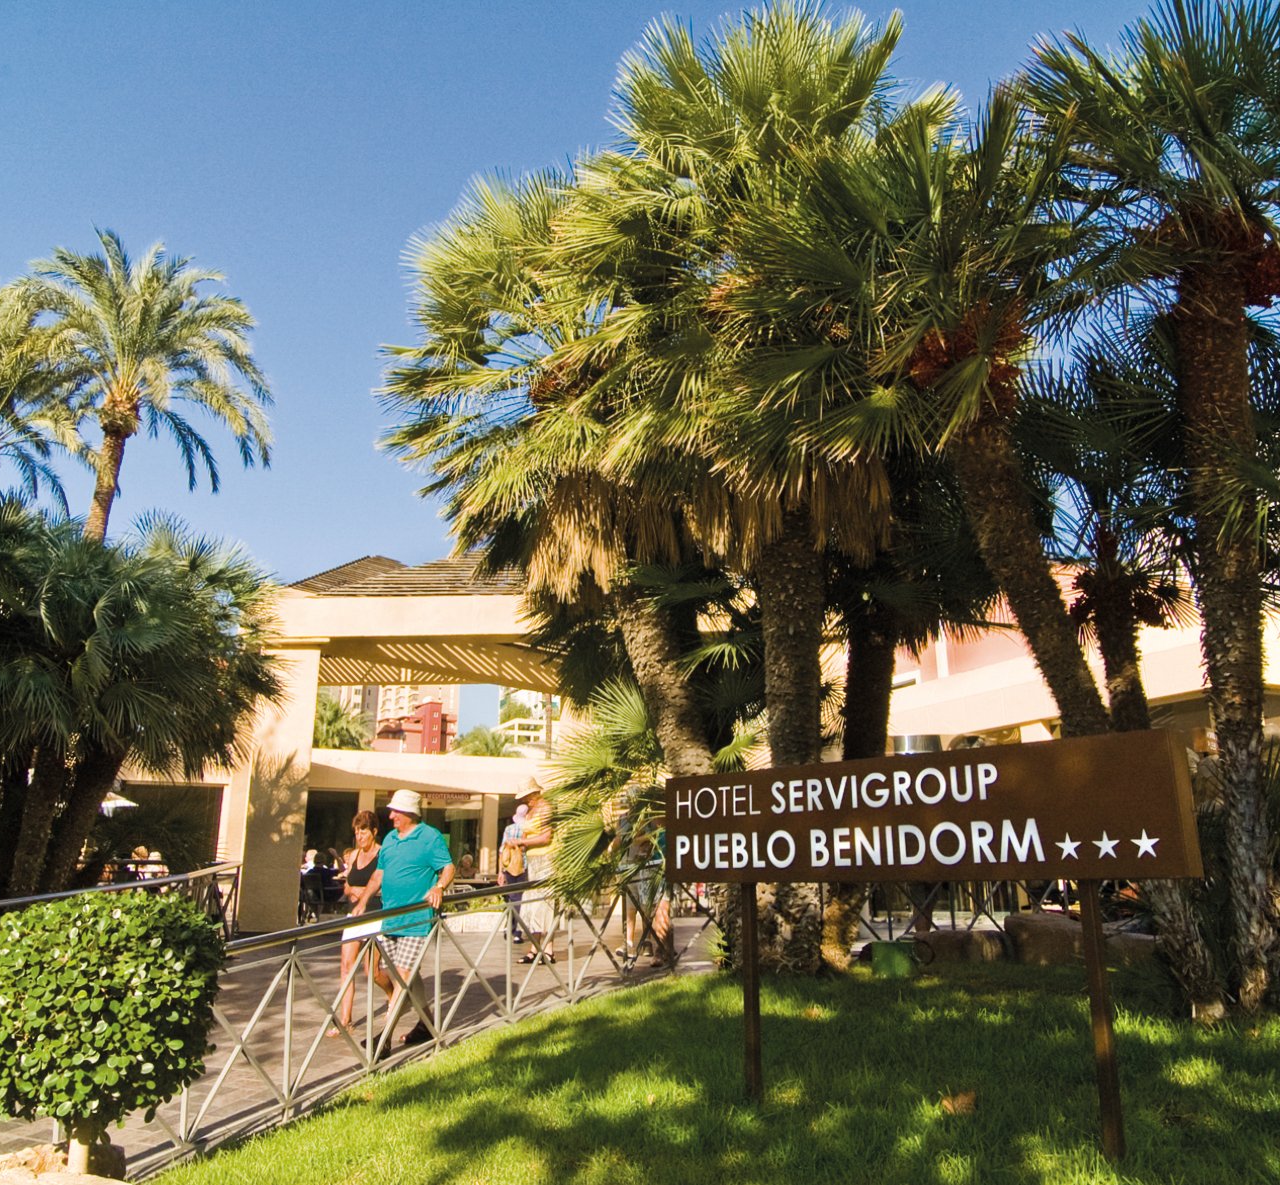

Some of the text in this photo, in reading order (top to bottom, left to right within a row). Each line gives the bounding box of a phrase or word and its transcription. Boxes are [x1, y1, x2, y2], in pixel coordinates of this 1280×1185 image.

[676, 763, 998, 819] HOTEL SERVIGROUP
[675, 818, 1046, 870] PUEBLO BENIDORM
